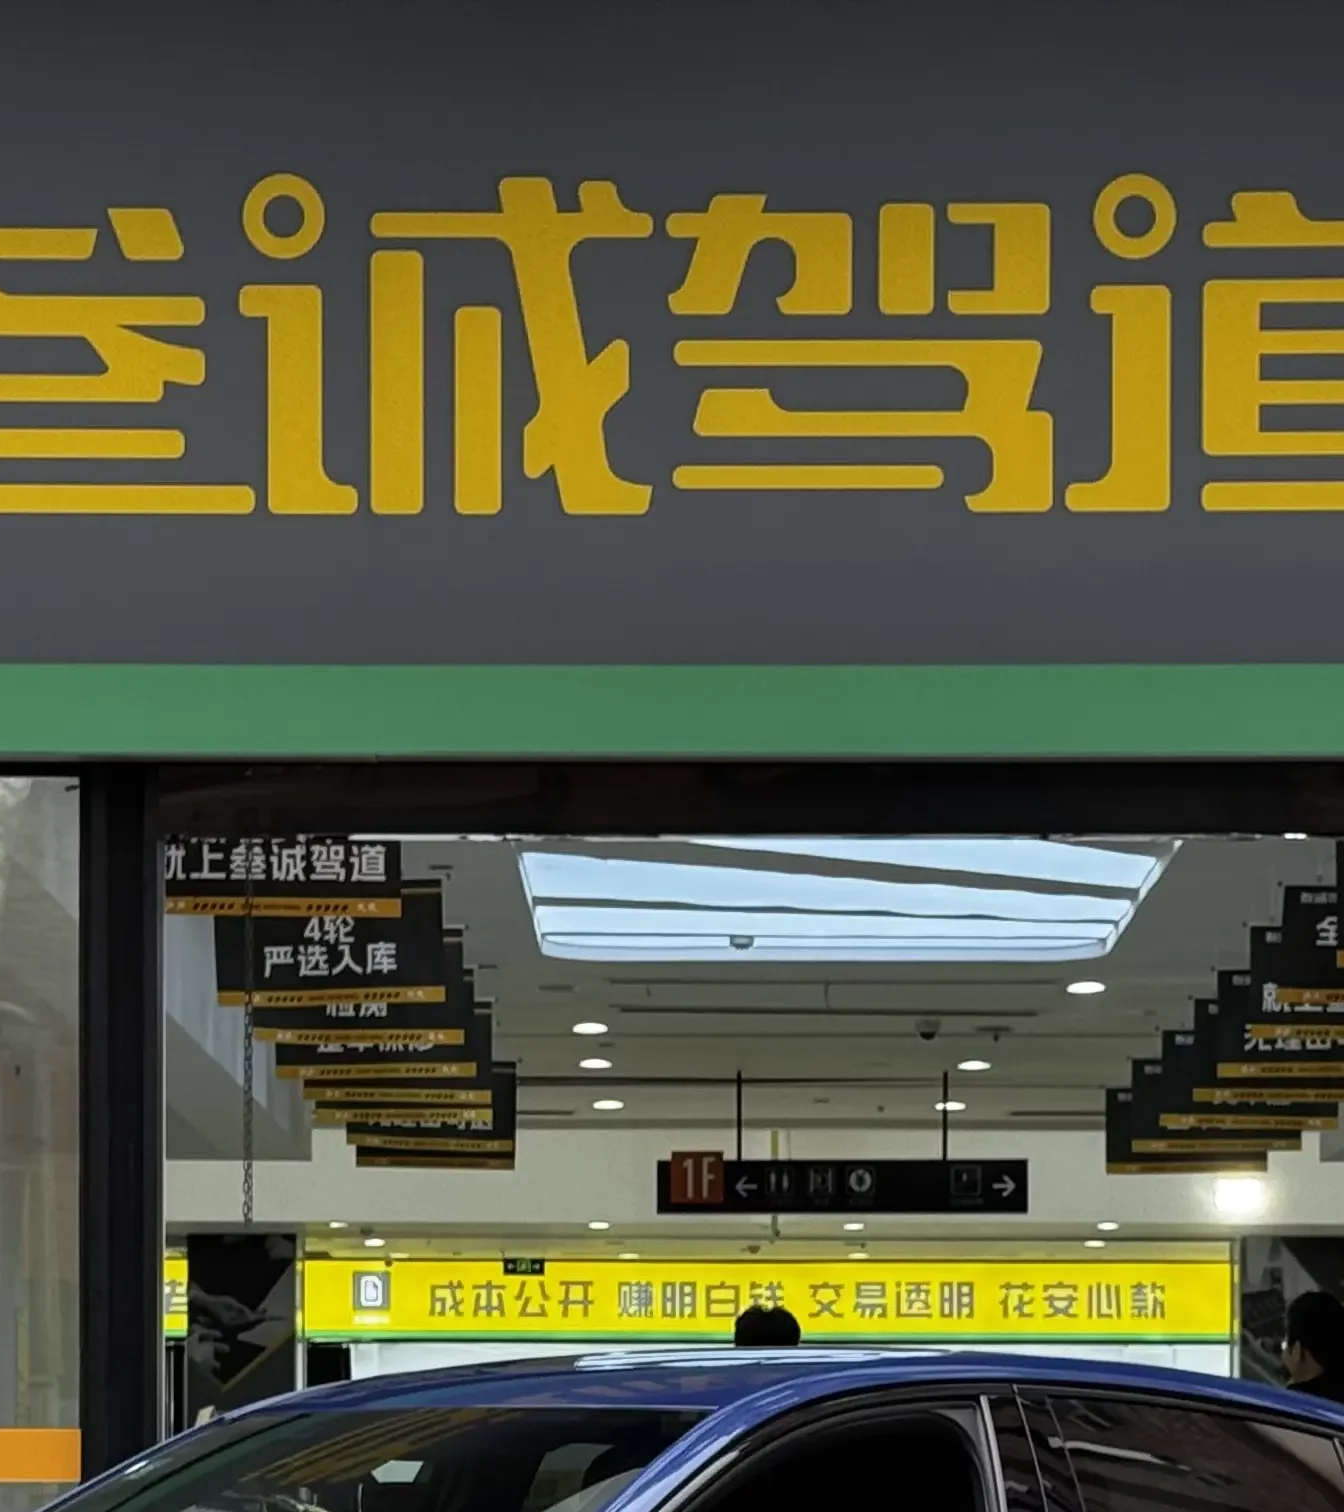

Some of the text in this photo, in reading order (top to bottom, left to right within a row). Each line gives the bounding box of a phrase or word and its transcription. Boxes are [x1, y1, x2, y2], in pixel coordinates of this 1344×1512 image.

[263, 942, 398, 978] 严选入库
[682, 1156, 717, 1199] 1F
[429, 1280, 595, 1318] 成本公开
[808, 1281, 975, 1320] 交易透明
[999, 1281, 1167, 1320] 花安心款
